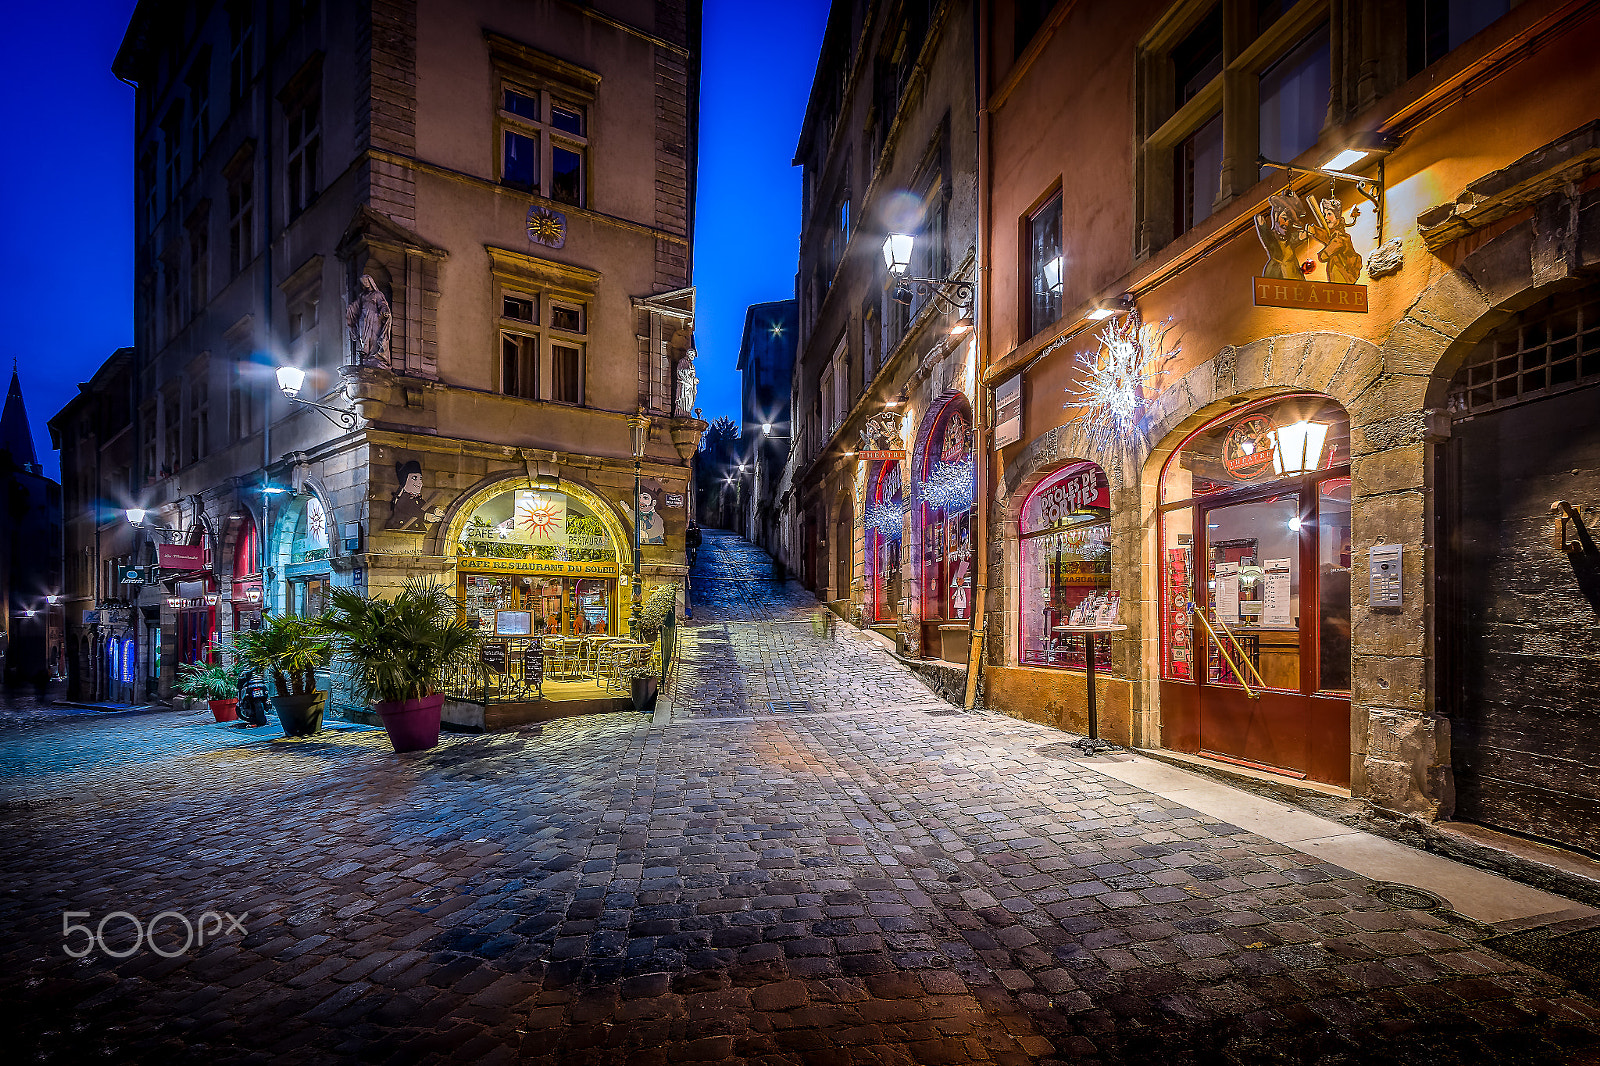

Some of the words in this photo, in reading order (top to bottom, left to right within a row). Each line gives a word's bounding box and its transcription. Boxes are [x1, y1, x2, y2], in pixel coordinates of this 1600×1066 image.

[1257, 284, 1366, 306] THÉÂTRE
[1081, 467, 1098, 487] DE
[568, 535, 609, 547] RESTAURA
[492, 561, 564, 573] RESTAURANT
[567, 564, 583, 573] DU
[584, 566, 617, 574] SOLEIL
